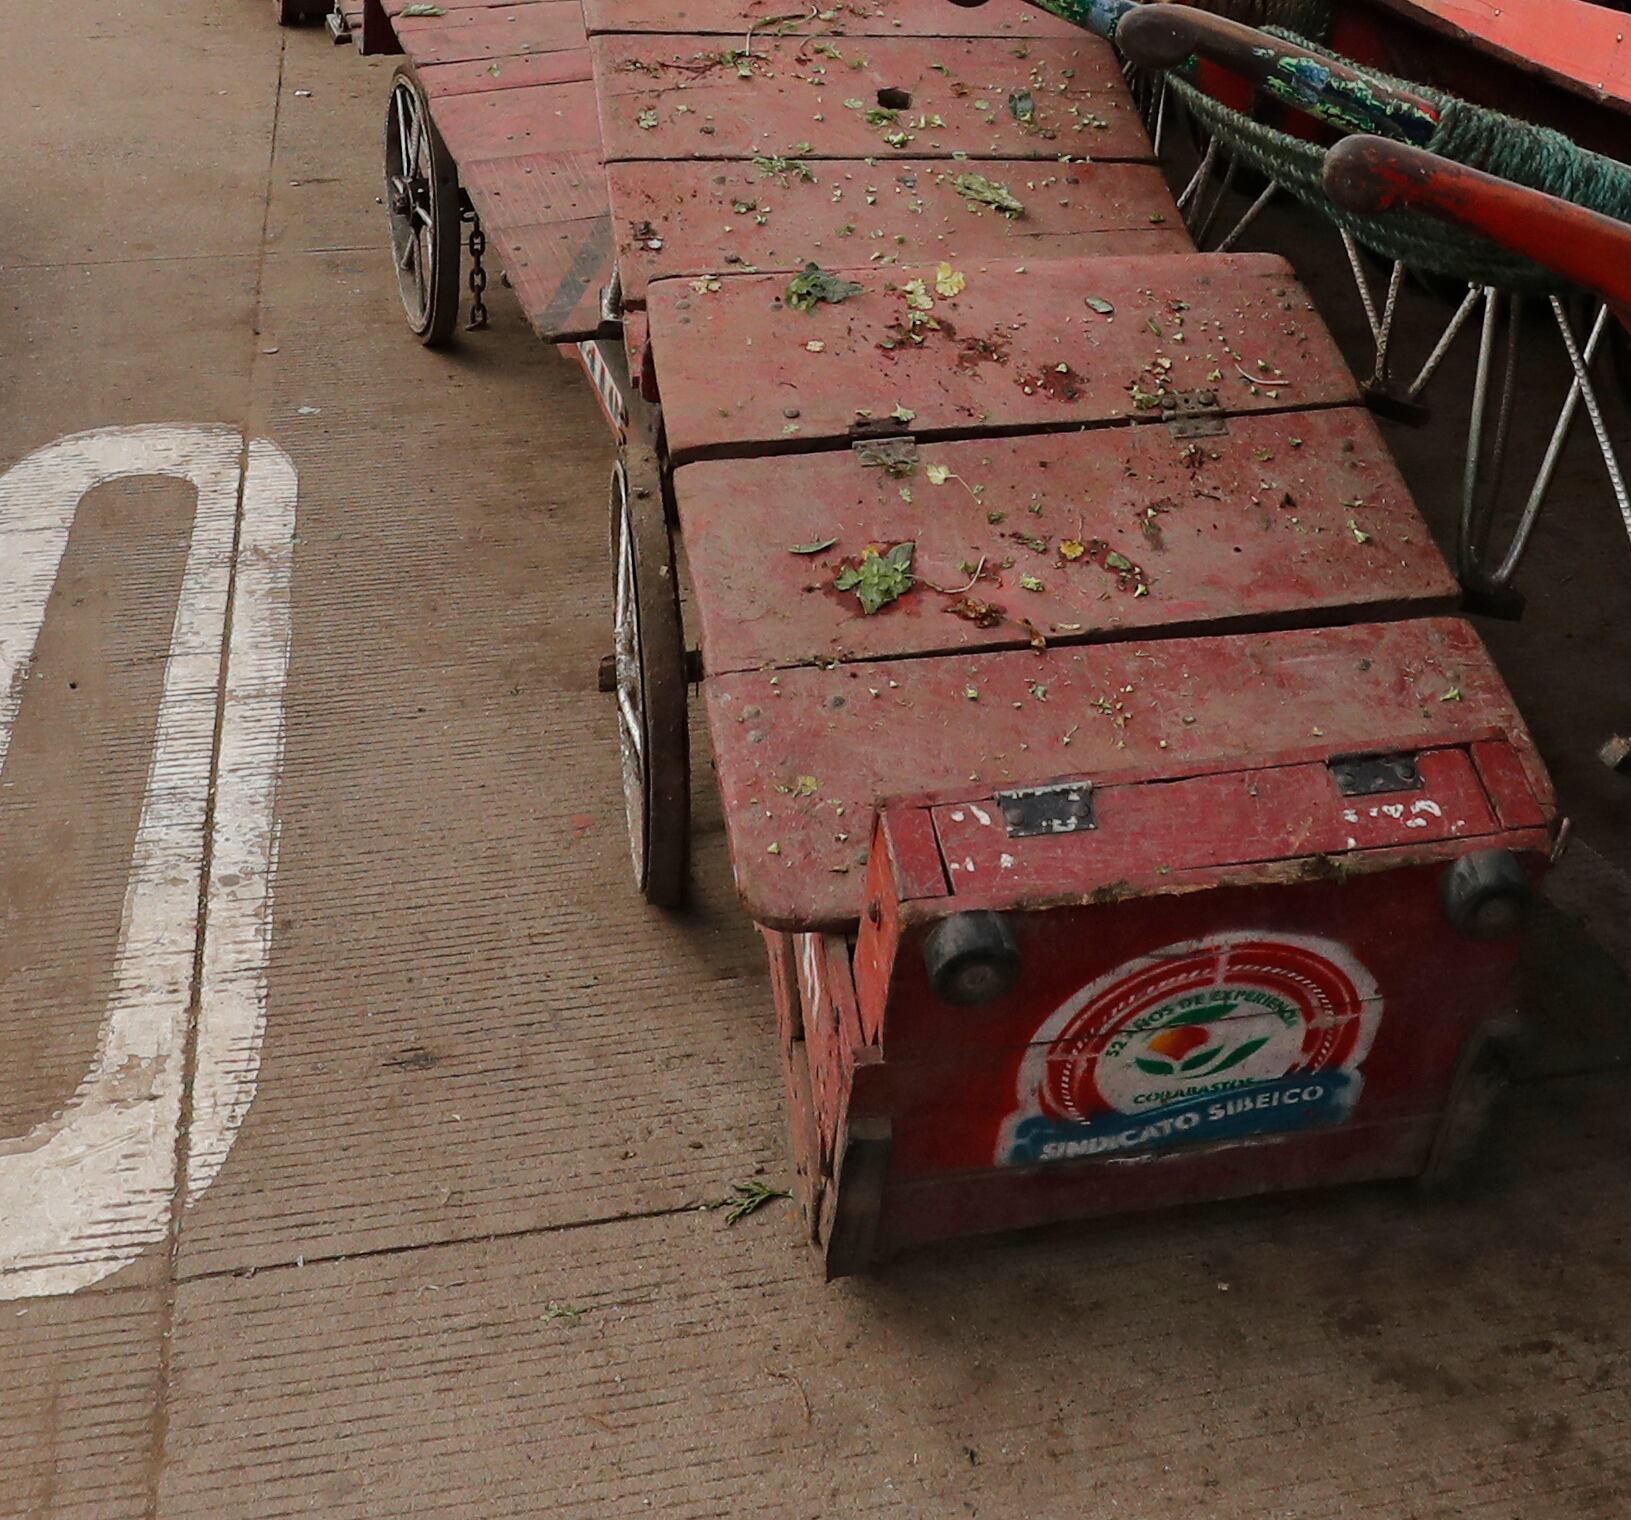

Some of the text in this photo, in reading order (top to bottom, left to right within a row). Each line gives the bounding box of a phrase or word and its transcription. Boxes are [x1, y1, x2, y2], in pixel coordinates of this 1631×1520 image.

[1105, 1038, 1127, 1058] 52
[1178, 993, 1207, 1009] DE
[1039, 1112, 1200, 1160] SINDICATO
